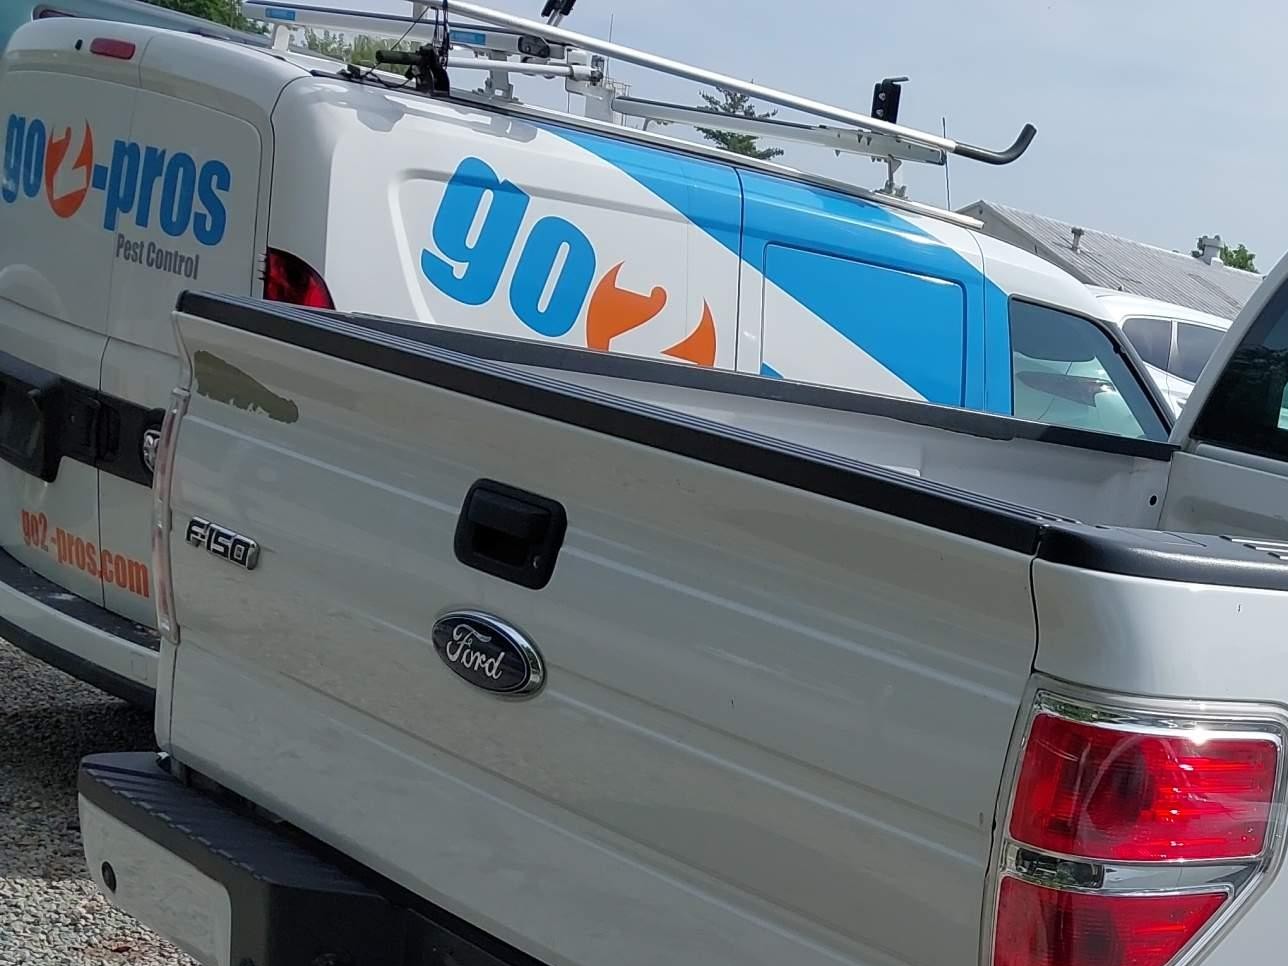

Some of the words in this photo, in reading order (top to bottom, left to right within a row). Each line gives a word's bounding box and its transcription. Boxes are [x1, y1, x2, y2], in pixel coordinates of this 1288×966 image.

[116, 234, 144, 268] Pest
[146, 242, 200, 280] Control
[446, 623, 505, 680] Ford
